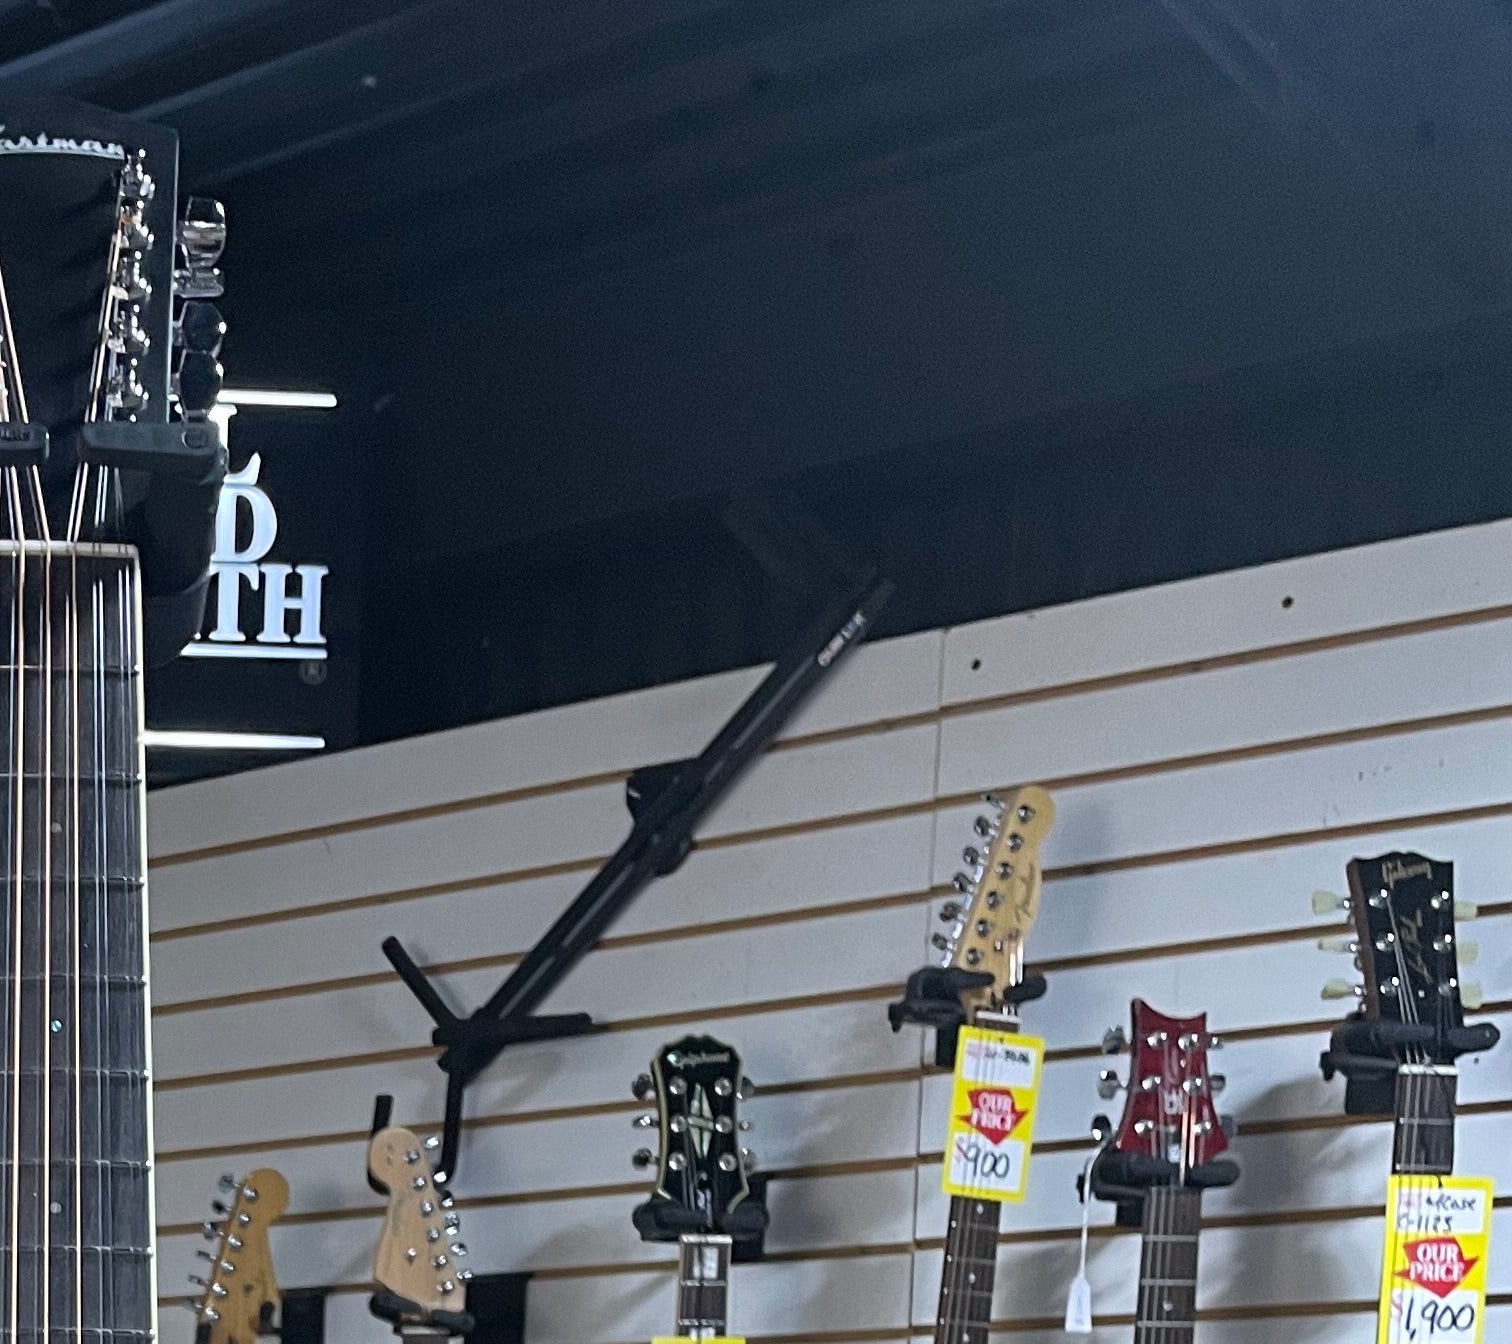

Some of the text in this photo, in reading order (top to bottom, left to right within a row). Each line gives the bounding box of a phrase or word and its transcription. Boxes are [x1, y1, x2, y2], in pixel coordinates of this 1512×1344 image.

[978, 1091, 1012, 1112] OUR
[970, 1107, 1016, 1130] PRICE
[1416, 1242, 1459, 1262] OUR
[1409, 1262, 1464, 1283] PRICE
